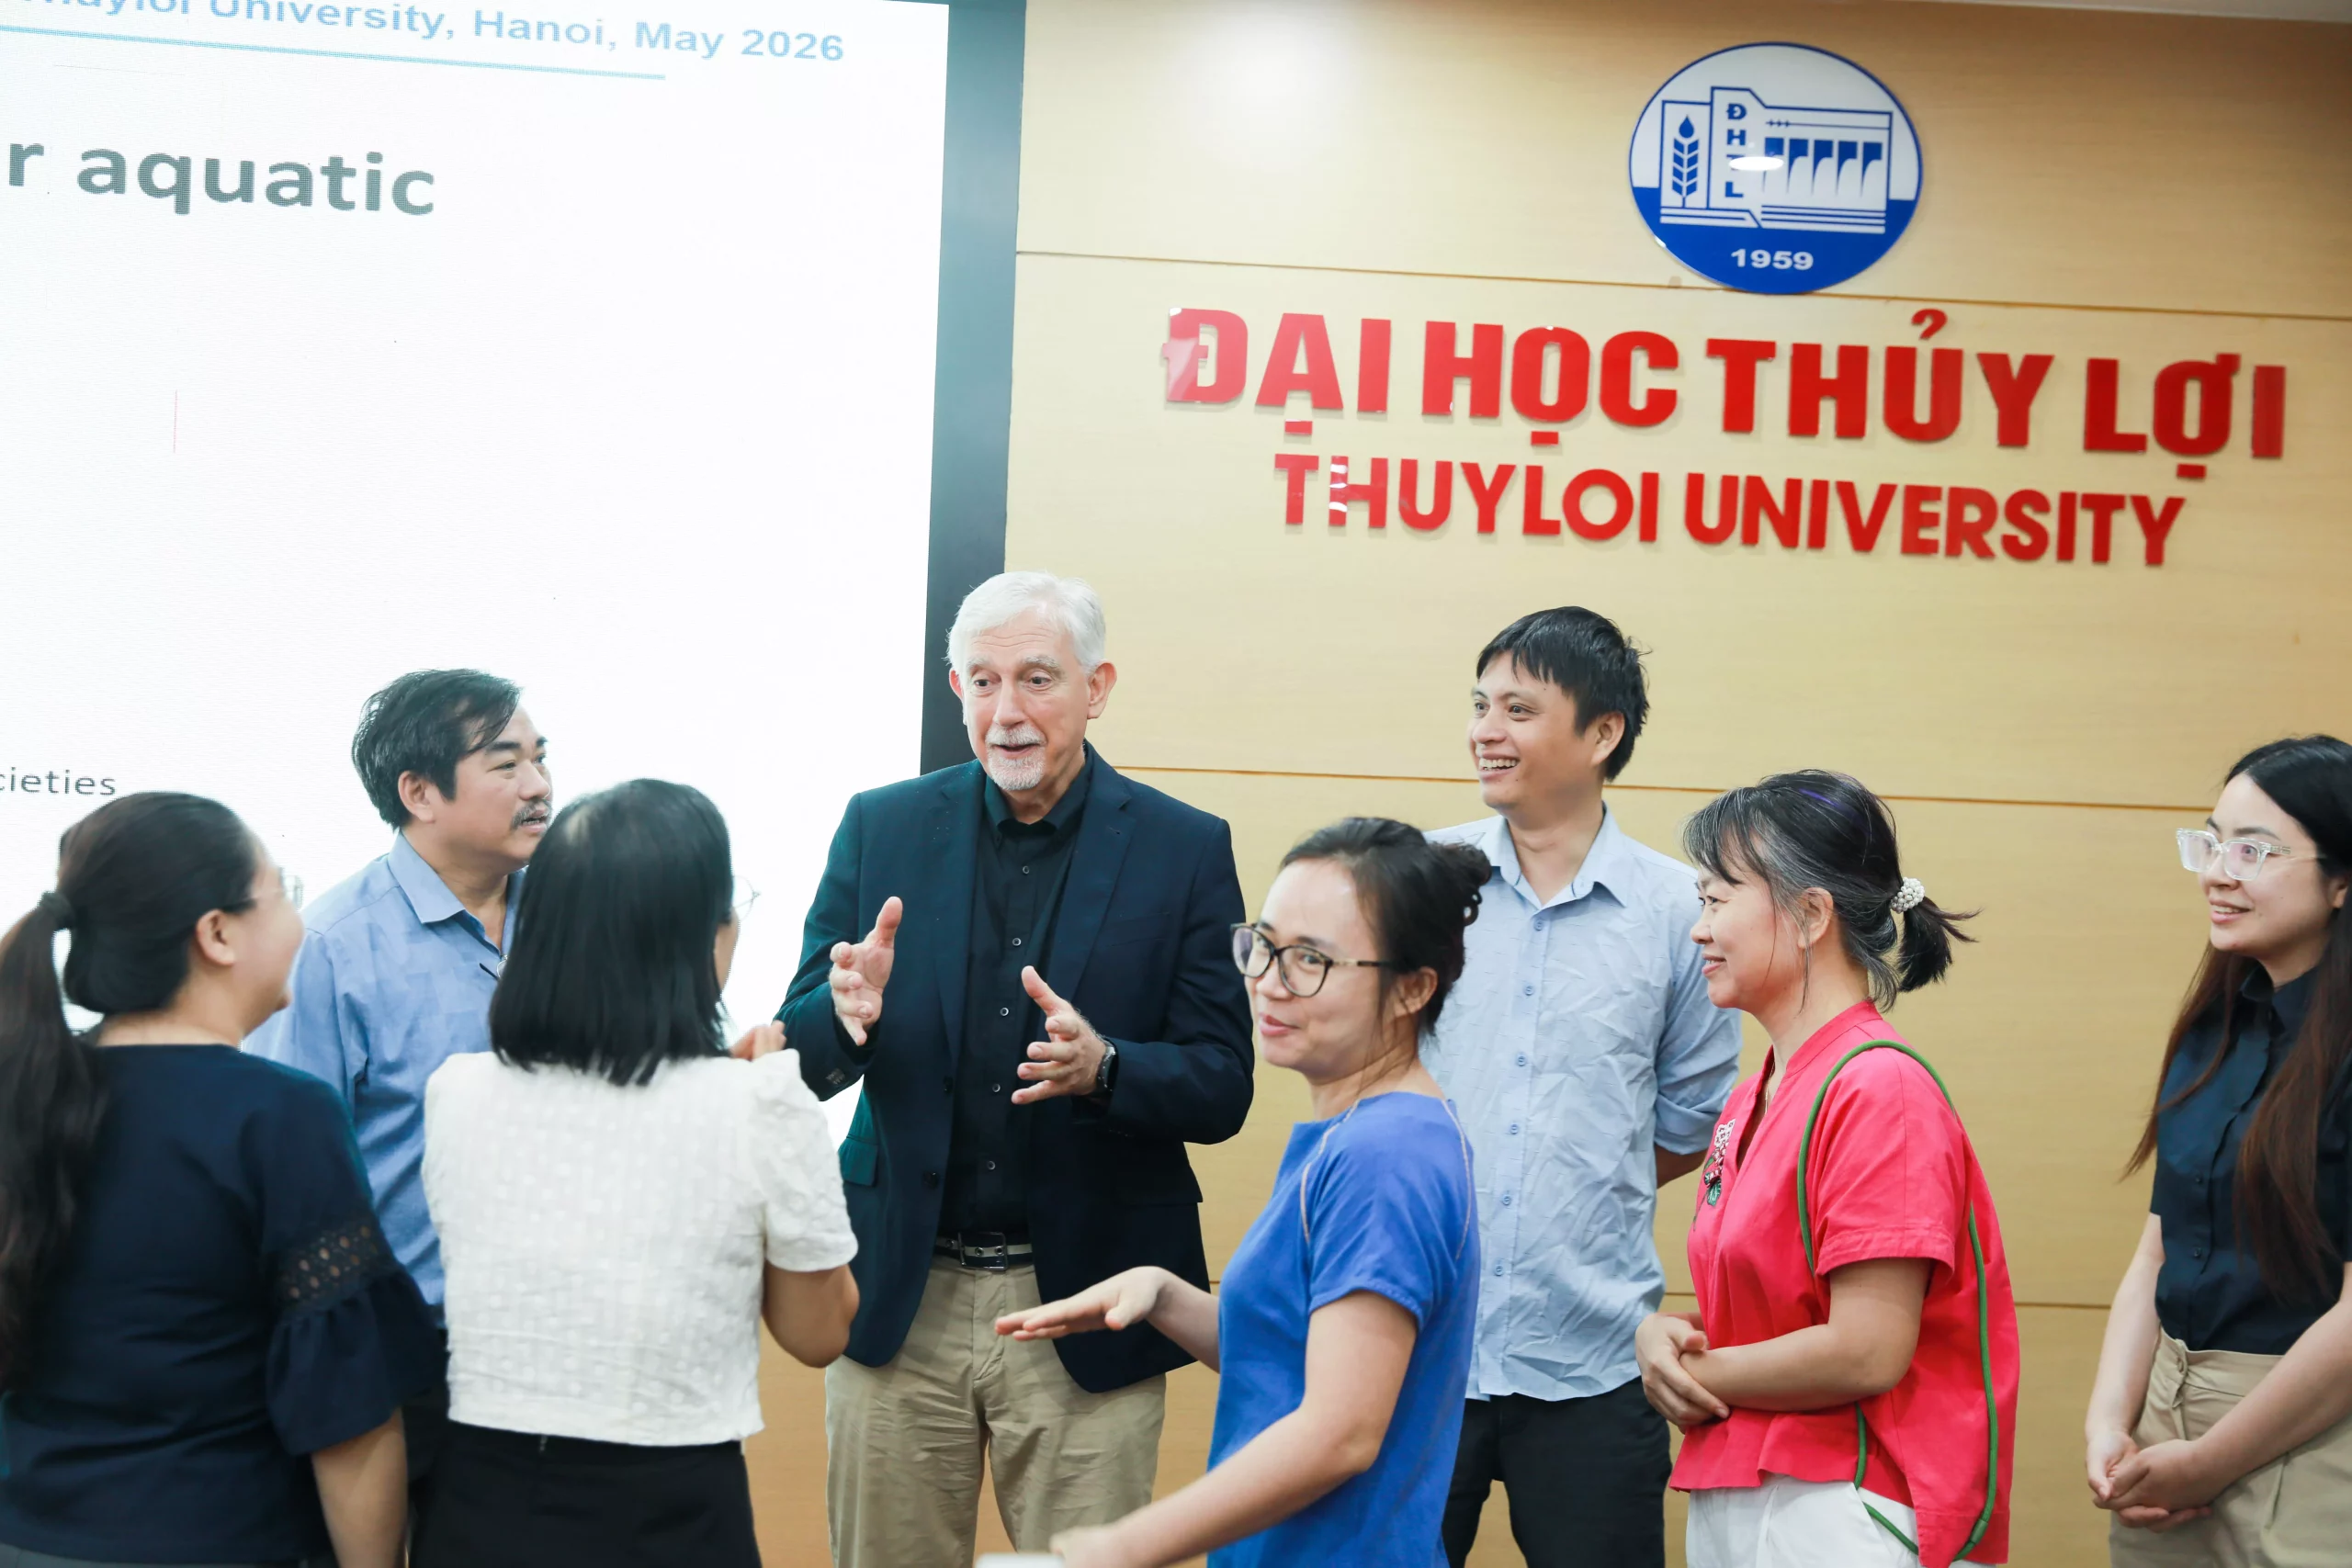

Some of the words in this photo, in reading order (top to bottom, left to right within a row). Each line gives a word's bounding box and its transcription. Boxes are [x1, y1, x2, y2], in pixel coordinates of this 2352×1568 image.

[209, 0, 454, 39] University,
[474, 10, 616, 51] Hanoi,
[635, 22, 724, 60] May
[741, 29, 843, 61] 2026
[77, 149, 435, 215] aquatic
[1731, 248, 1814, 270] 1959
[1162, 308, 1391, 435] ĐẠI
[1422, 321, 1679, 446] HỌC
[1706, 308, 2055, 447] THỦY
[2084, 353, 2287, 479] LỢI
[1274, 453, 1660, 542] THUYLOI
[1684, 472, 2186, 566] UNIVERSITY
